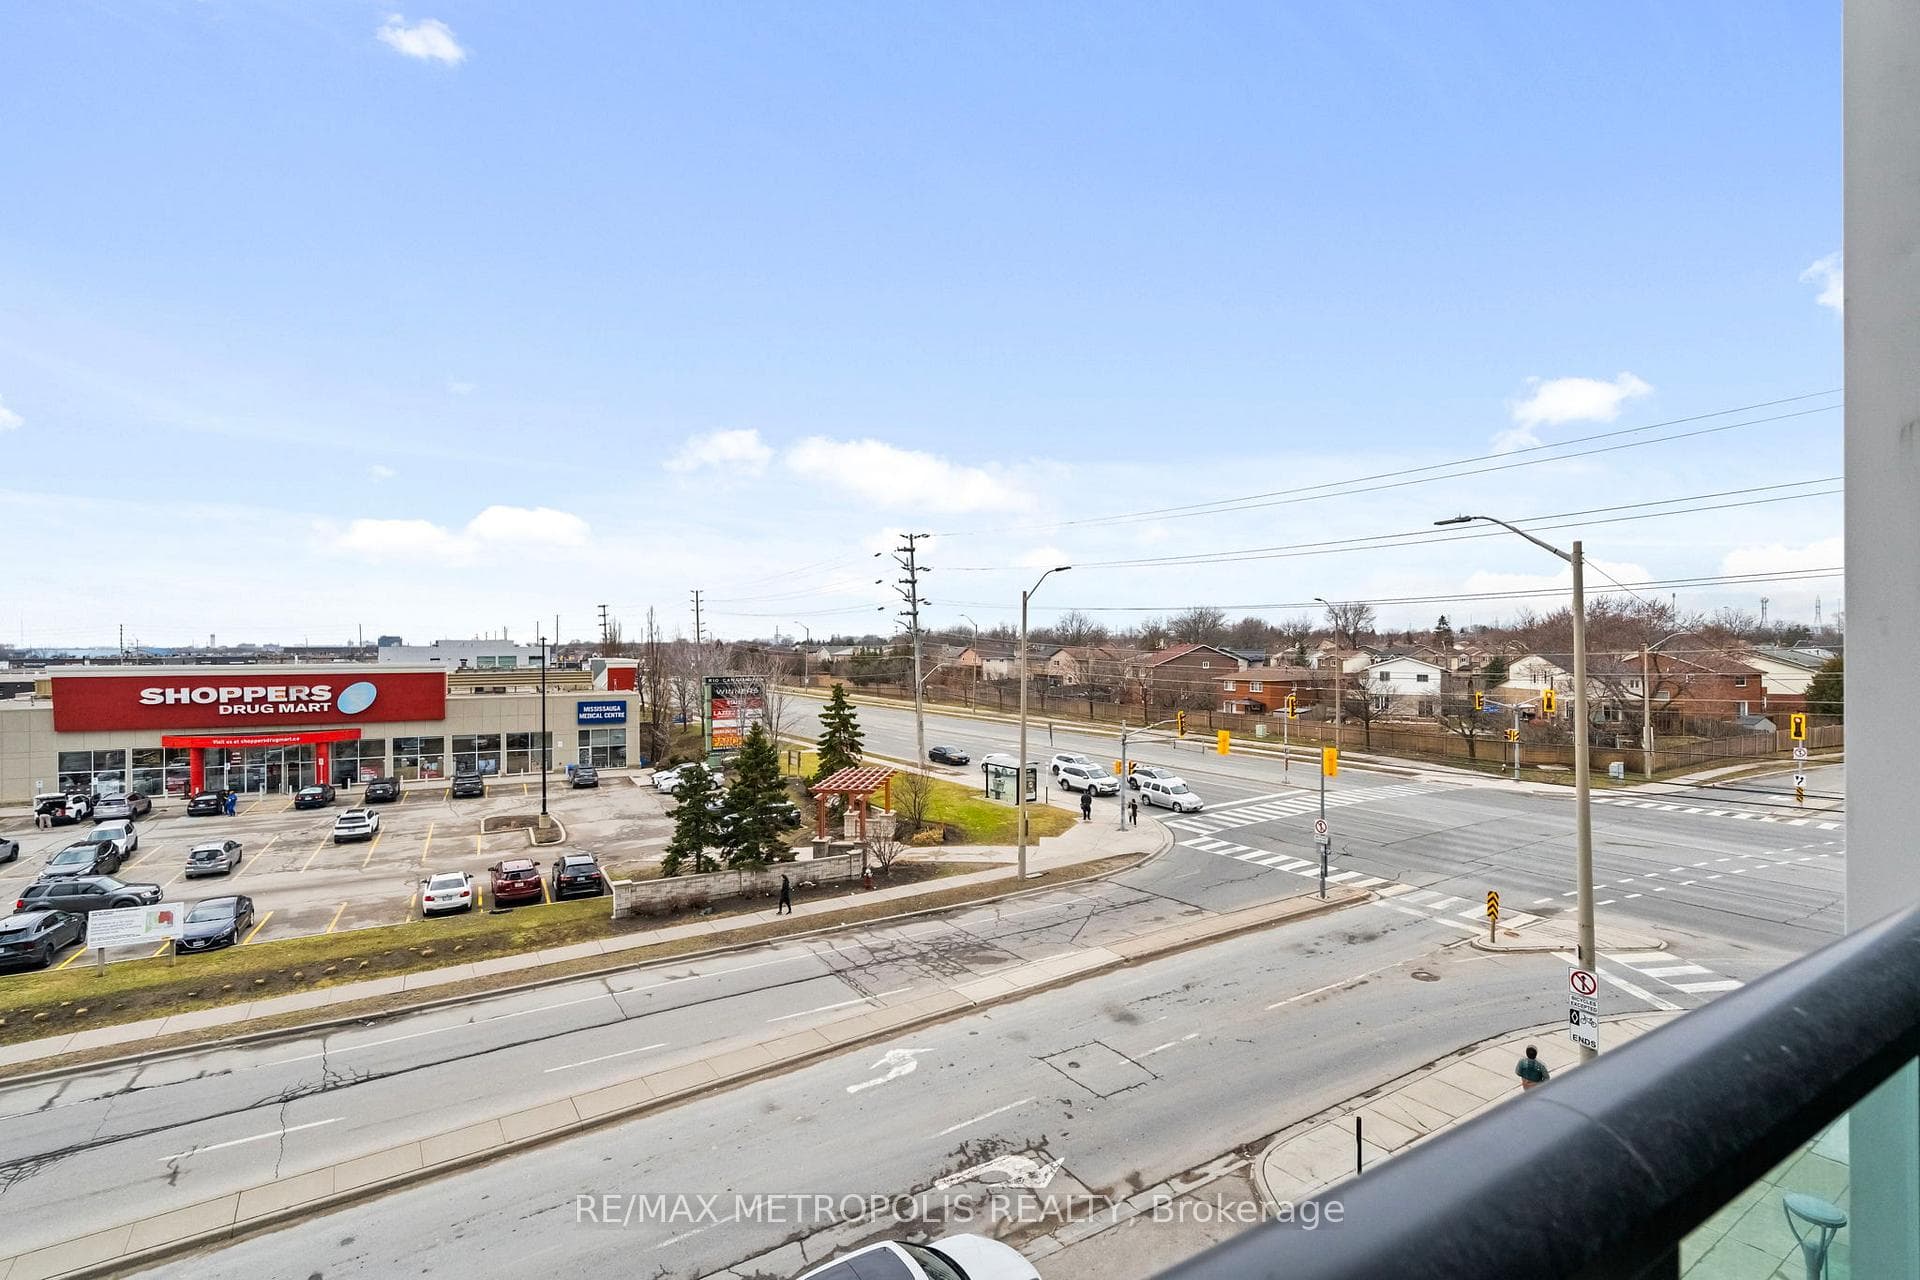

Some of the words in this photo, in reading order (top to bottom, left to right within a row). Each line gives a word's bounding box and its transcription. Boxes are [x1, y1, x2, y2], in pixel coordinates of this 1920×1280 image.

[138, 685, 332, 705] SHOPPERS
[716, 687, 759, 695] WINNERS
[219, 704, 274, 715] DRUG
[278, 702, 332, 714] MART
[240, 736, 300, 744] shoppersdrugmart.ca
[1571, 995, 1596, 1006] BICYCLES
[1571, 1001, 1597, 1012] EXCEPTED
[1572, 1034, 1597, 1048] ENDS
